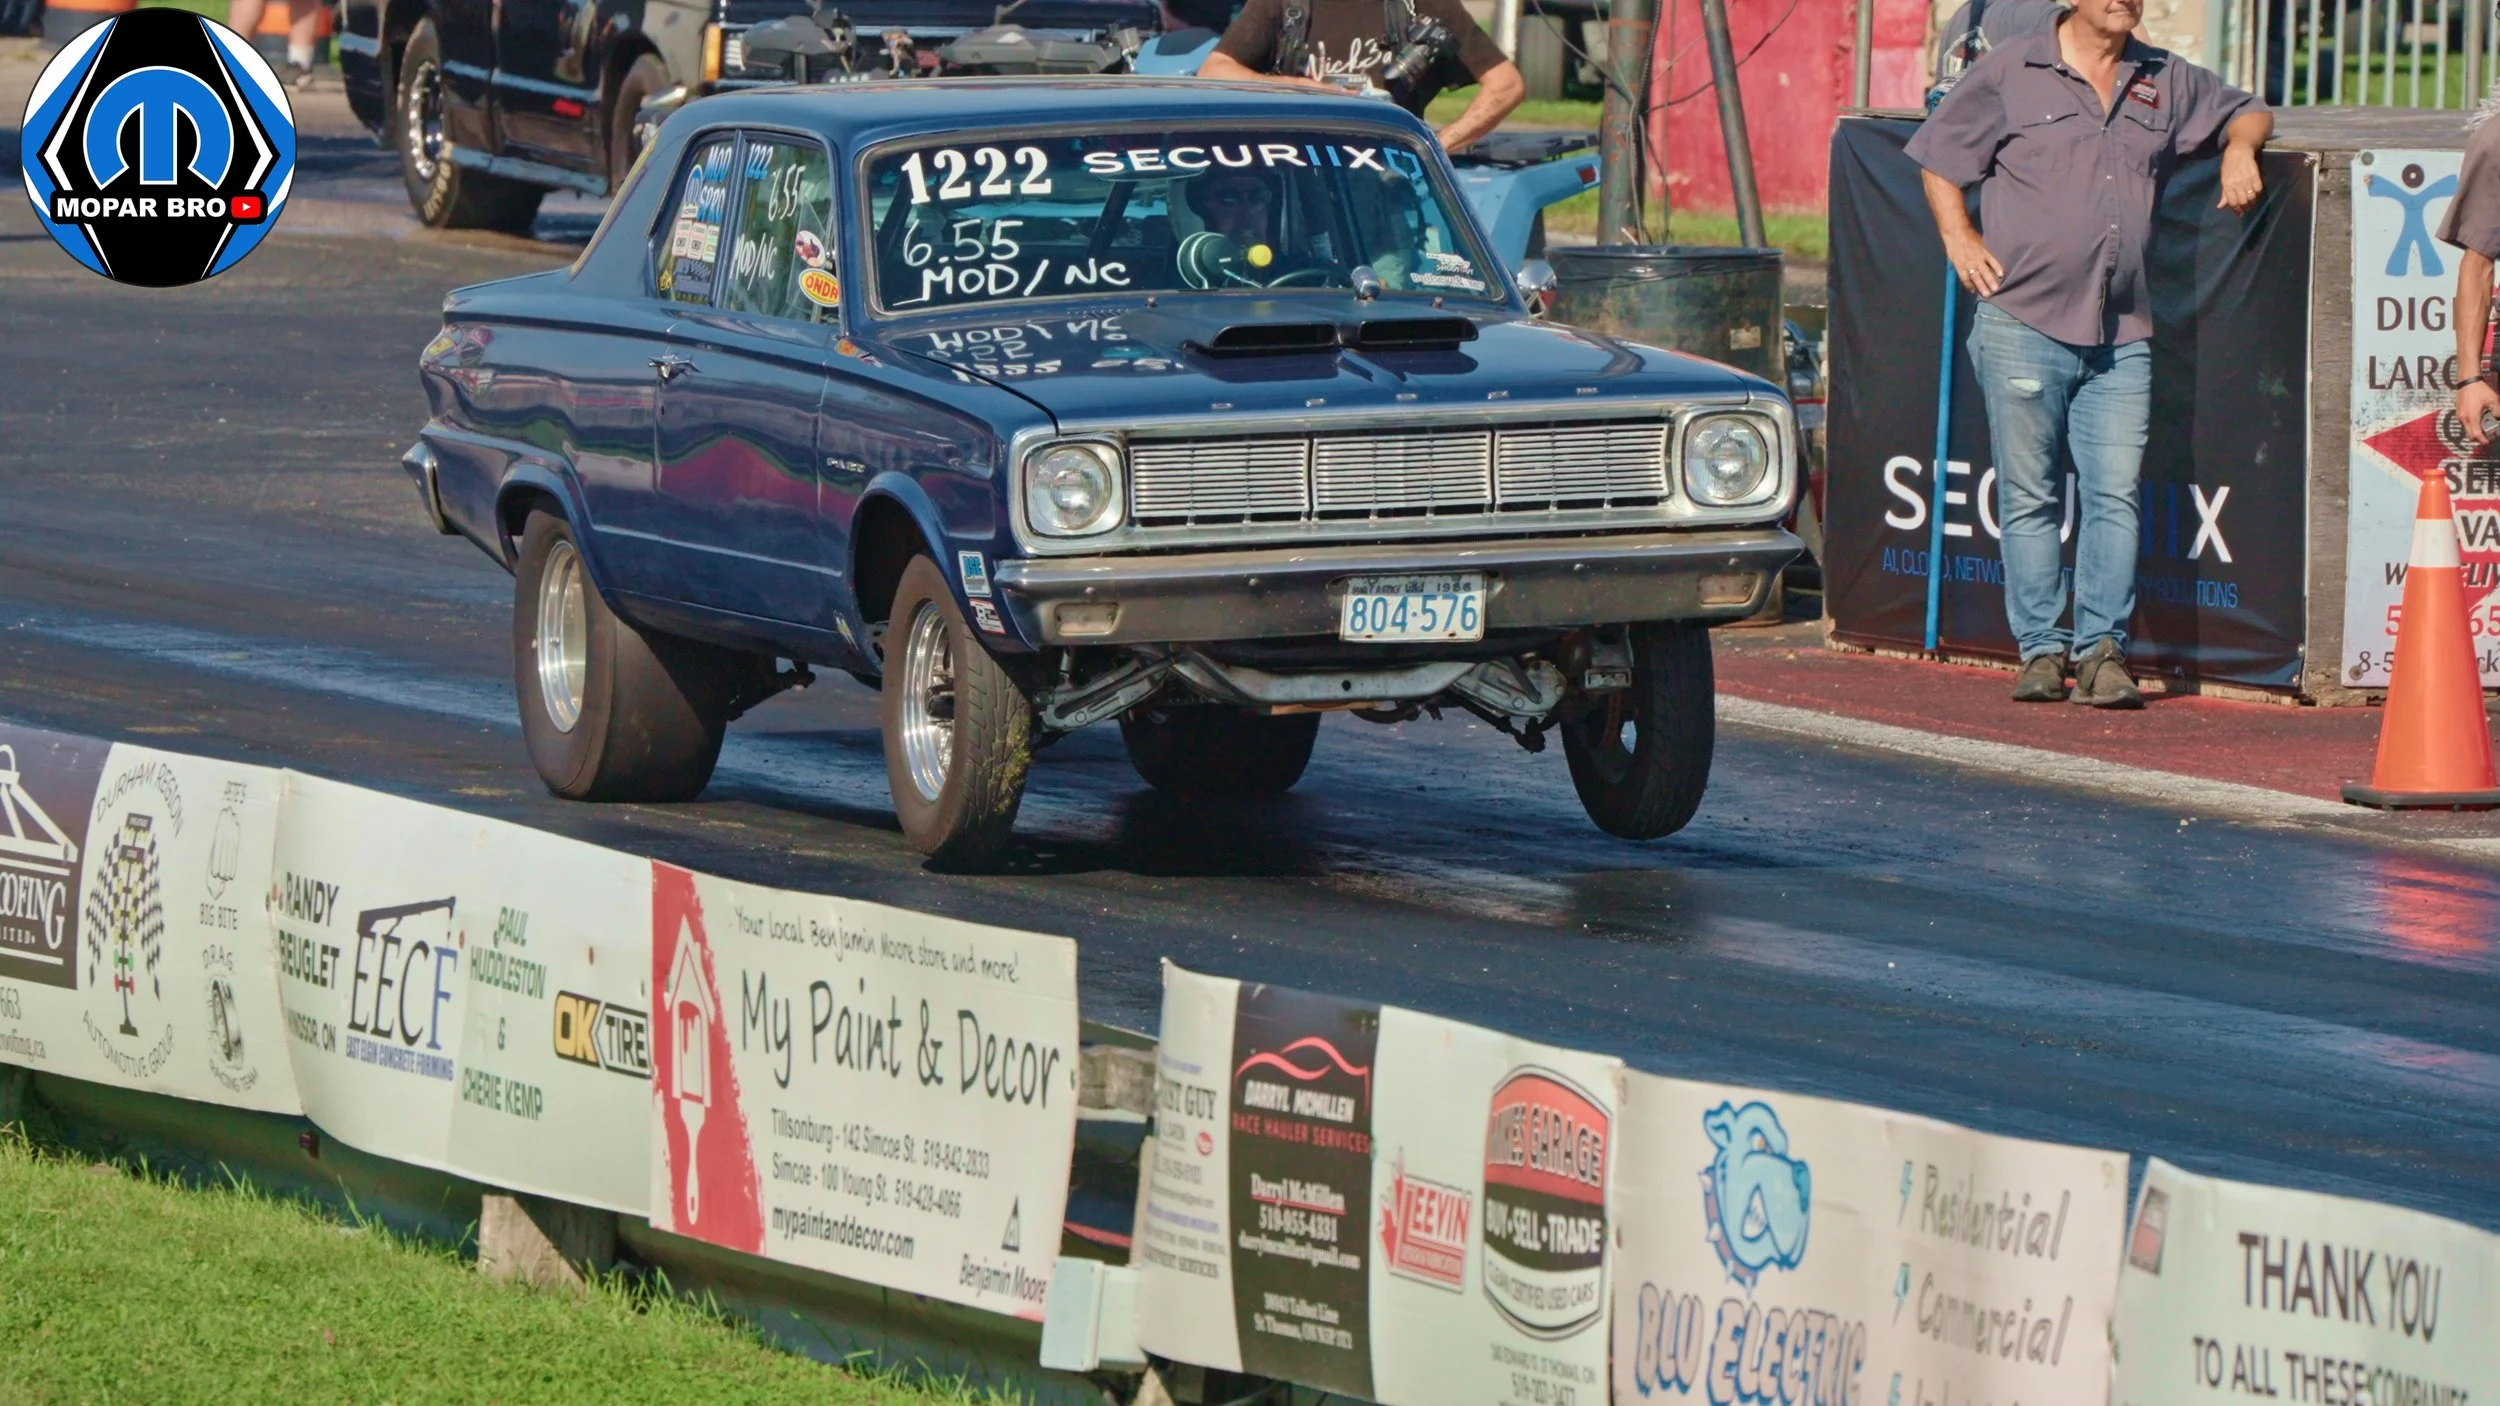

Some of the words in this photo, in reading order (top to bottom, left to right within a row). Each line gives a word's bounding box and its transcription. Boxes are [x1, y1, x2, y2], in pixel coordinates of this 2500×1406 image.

[901, 146, 1052, 205] 1222
[1083, 144, 1386, 174] SECURIIX
[768, 163, 807, 222] 6.55
[902, 218, 1024, 267] 6.55
[96, 760, 155, 823] DURHAM
[156, 763, 184, 839] REGION
[218, 905, 238, 931] BITE
[285, 871, 340, 928] RANDY
[499, 905, 529, 947] PAUL
[278, 929, 340, 990] BEUGLET
[734, 905, 764, 938] Your
[768, 910, 805, 944] local
[809, 916, 876, 962] Benjamin
[880, 932, 915, 964] Moore
[918, 935, 949, 971] store
[952, 943, 976, 975] and
[347, 930, 459, 1051] EECF
[470, 945, 547, 1000] HUDDLESTON
[83, 1008, 148, 1079] AUTOMOTIVE
[148, 1023, 174, 1074] GROUP
[322, 1021, 337, 1054] ON
[554, 994, 599, 1063] OK
[604, 1014, 648, 1069] TIRE
[741, 968, 791, 1089] My
[809, 976, 904, 1079] Paint
[917, 997, 944, 1087] &
[957, 1009, 1061, 1110] Decor
[462, 1067, 501, 1111] CHERIE
[504, 1079, 544, 1122] KEMP
[1185, 1084, 1217, 1121] GUY
[1243, 1079, 1291, 1113] DARRYL
[771, 1107, 834, 1153] Tillsonburg
[863, 1125, 901, 1161] Simcoe
[1232, 1111, 1260, 1136] RACE
[1264, 1116, 1309, 1143] HAULER
[1311, 1125, 1371, 1154] SERVICES
[1528, 1102, 1604, 1189] GARAGE
[772, 1151, 812, 1187] Simcoe
[841, 1166, 874, 1207] Young
[1250, 1172, 1289, 1208] Darryl
[771, 1204, 915, 1260] mypaintanddecor.com
[1512, 1205, 1542, 1252] SELL
[1547, 1212, 1603, 1255] TRADE
[1919, 1162, 2072, 1263] Residential
[958, 1253, 1011, 1298] Benjamin
[1011, 1265, 1048, 1304] Moore
[2237, 1231, 2377, 1328] THANK
[2384, 1253, 2442, 1344] YOU
[1634, 1281, 1704, 1398] BLU
[1916, 1271, 2073, 1367] Commercial
[2193, 1336, 2224, 1389] TO
[2231, 1343, 2278, 1398] ALL
[2284, 1352, 2366, 1406] THESE
